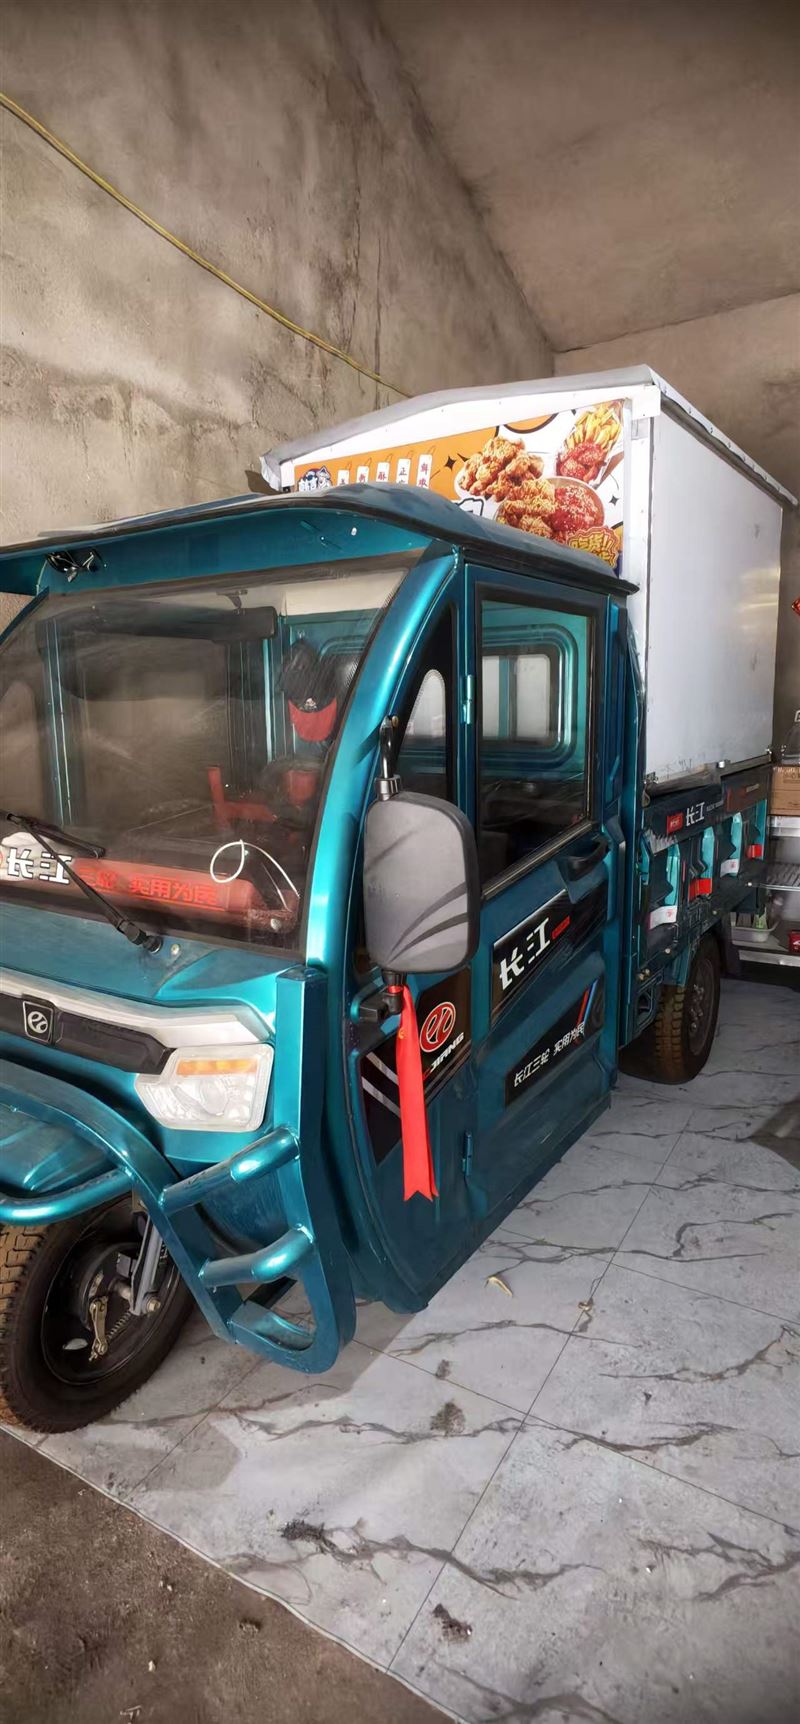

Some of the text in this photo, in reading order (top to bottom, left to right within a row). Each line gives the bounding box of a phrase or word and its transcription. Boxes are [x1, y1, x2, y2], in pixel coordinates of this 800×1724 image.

[685, 801, 705, 827] 长江
[7, 847, 72, 884] 长江
[499, 917, 551, 991] 长江
